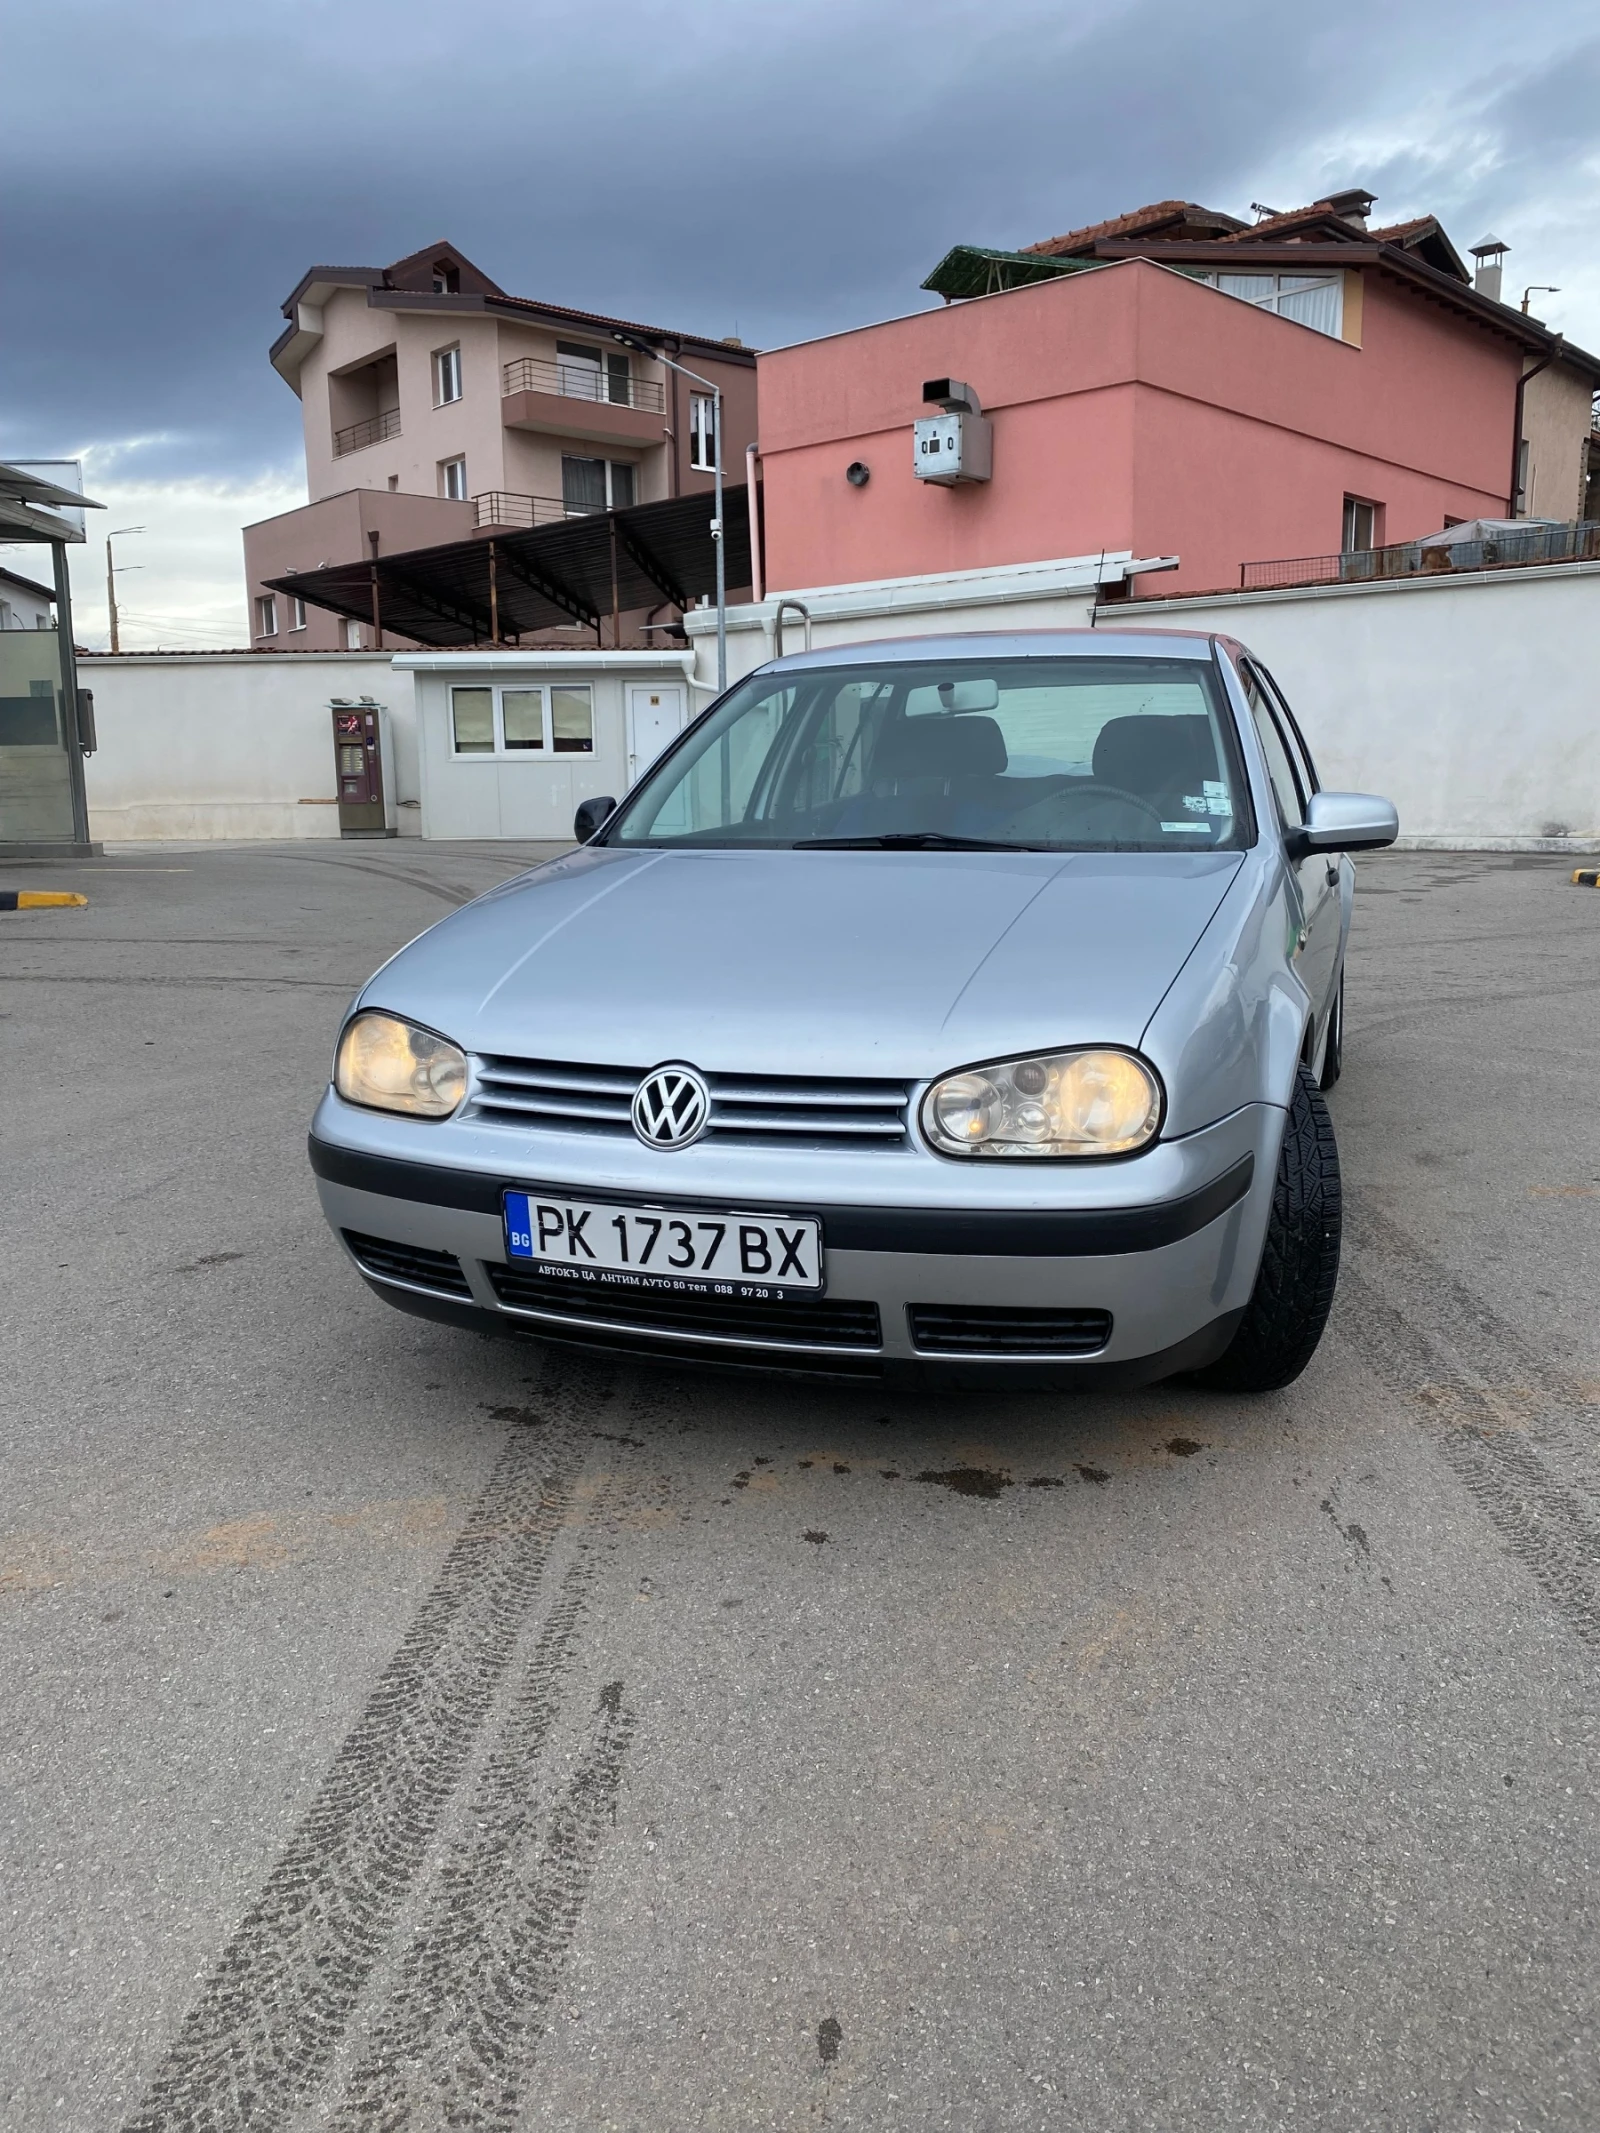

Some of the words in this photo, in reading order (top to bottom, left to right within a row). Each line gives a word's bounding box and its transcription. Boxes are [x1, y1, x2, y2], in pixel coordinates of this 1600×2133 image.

[634, 1068, 707, 1147] VW
[511, 1231, 531, 1248] BG
[536, 1205, 597, 1259] PK
[611, 1214, 726, 1271] 1737
[739, 1224, 809, 1279] BX
[600, 1273, 641, 1286] АНТИМ
[642, 1277, 672, 1289] АУТО
[673, 1280, 686, 1290] 80
[687, 1282, 708, 1292] тел
[714, 1284, 734, 1294] 088
